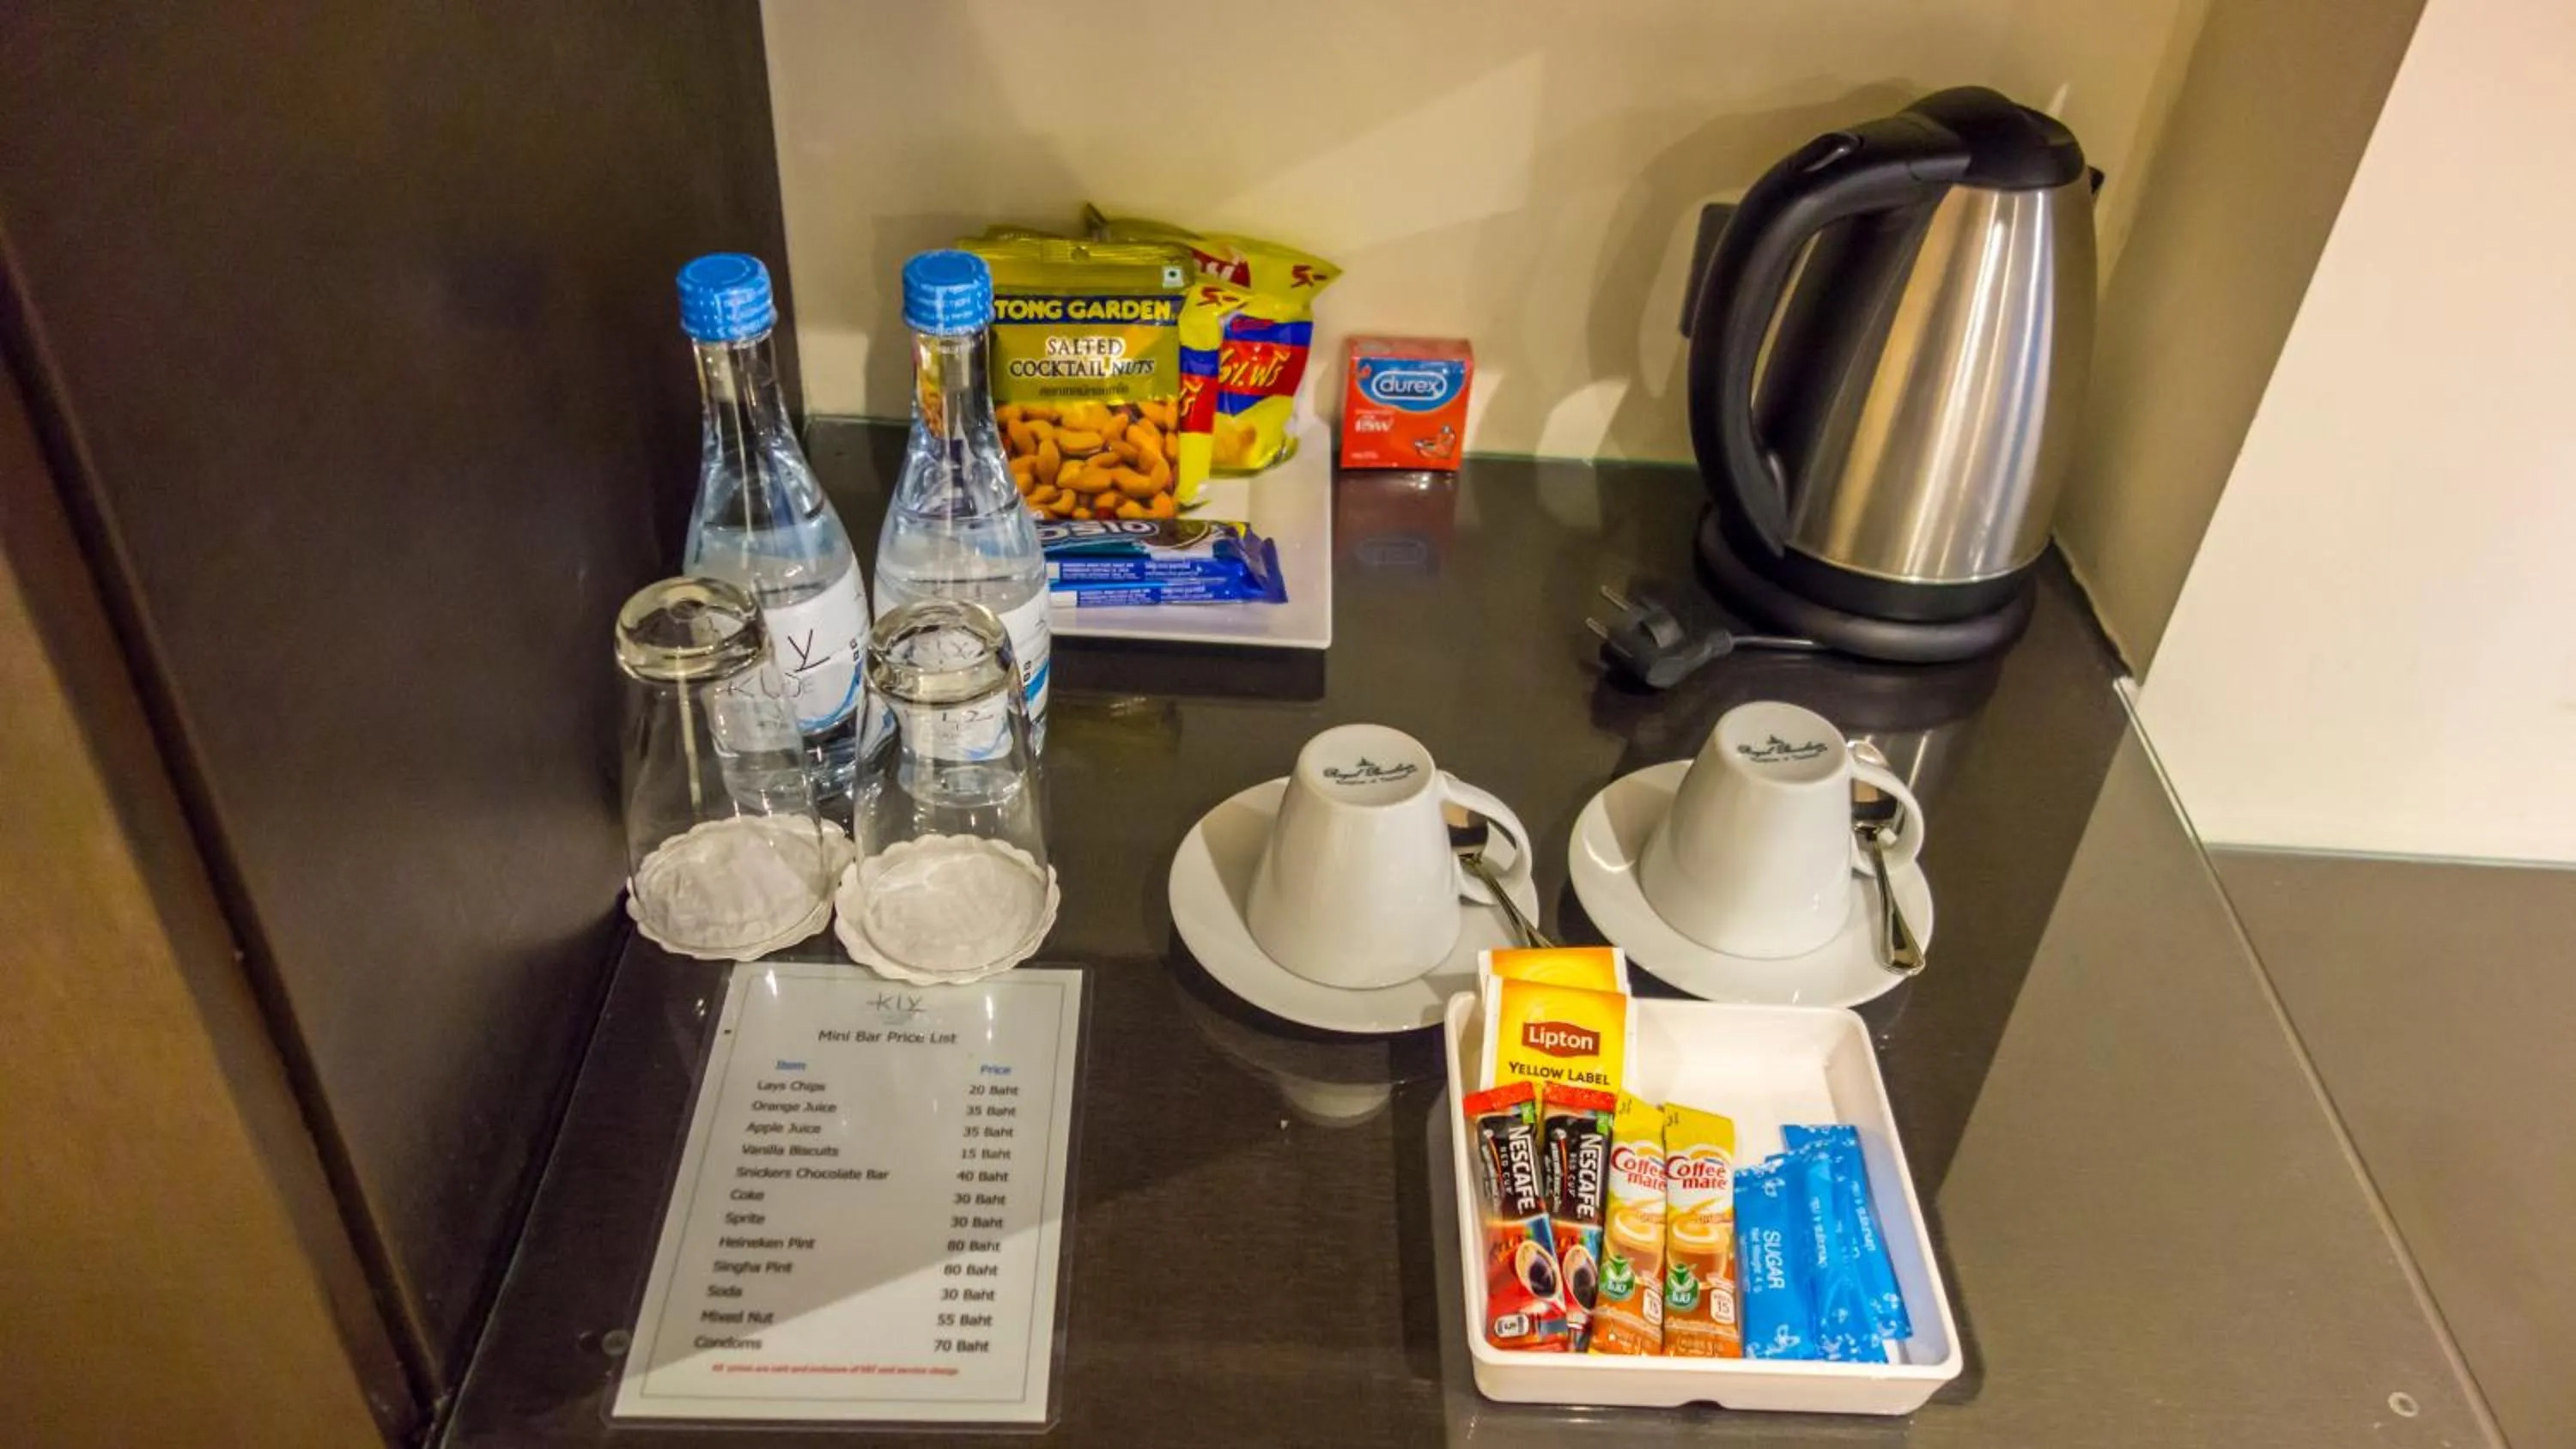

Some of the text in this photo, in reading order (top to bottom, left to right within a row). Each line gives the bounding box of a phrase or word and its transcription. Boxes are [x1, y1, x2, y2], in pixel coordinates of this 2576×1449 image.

[994, 299, 1171, 321] TONG GARDEN
[1047, 338, 1123, 355] SALTED
[1010, 360, 1155, 377] COCKTAIL NUTS
[1379, 374, 1439, 393] durex
[818, 1030, 958, 1045] Mini Bar Price List
[1528, 1026, 1594, 1051] Lipton
[980, 1064, 1012, 1076] Price
[1509, 1061, 1611, 1086] YELLOW LABEL
[757, 1080, 1019, 1097] Lays Chips 20 Baht
[751, 1100, 1017, 1118] Orange Juice 35 Baht
[745, 1122, 1013, 1138] Apple Juice 35 Baht
[742, 1143, 1012, 1161] Vanilla Biscuits 15 Baht
[1611, 1146, 1667, 1178] Coffee
[1667, 1155, 1726, 1180] Coffee
[736, 1166, 1009, 1183] Snickers Chocolate Bar 40 Baht
[1628, 1170, 1667, 1191] mate
[1682, 1177, 1728, 1191] mate
[730, 1189, 1006, 1206] Coke 30 Baht
[725, 1212, 1004, 1229] Sprite 30 Baht
[718, 1236, 784, 1249] Heineken
[787, 1237, 817, 1250] Pint
[969, 1240, 1001, 1253] Baht
[1763, 1229, 1785, 1289] SUGAR
[713, 1260, 761, 1276] Singha
[765, 1261, 794, 1274] Pint
[966, 1264, 998, 1277] Baht
[707, 1284, 995, 1302] Soda 30 Baht
[700, 1309, 993, 1327] Mixed Nut 55 Baht
[693, 1335, 990, 1354] Condoms 70 Baht
